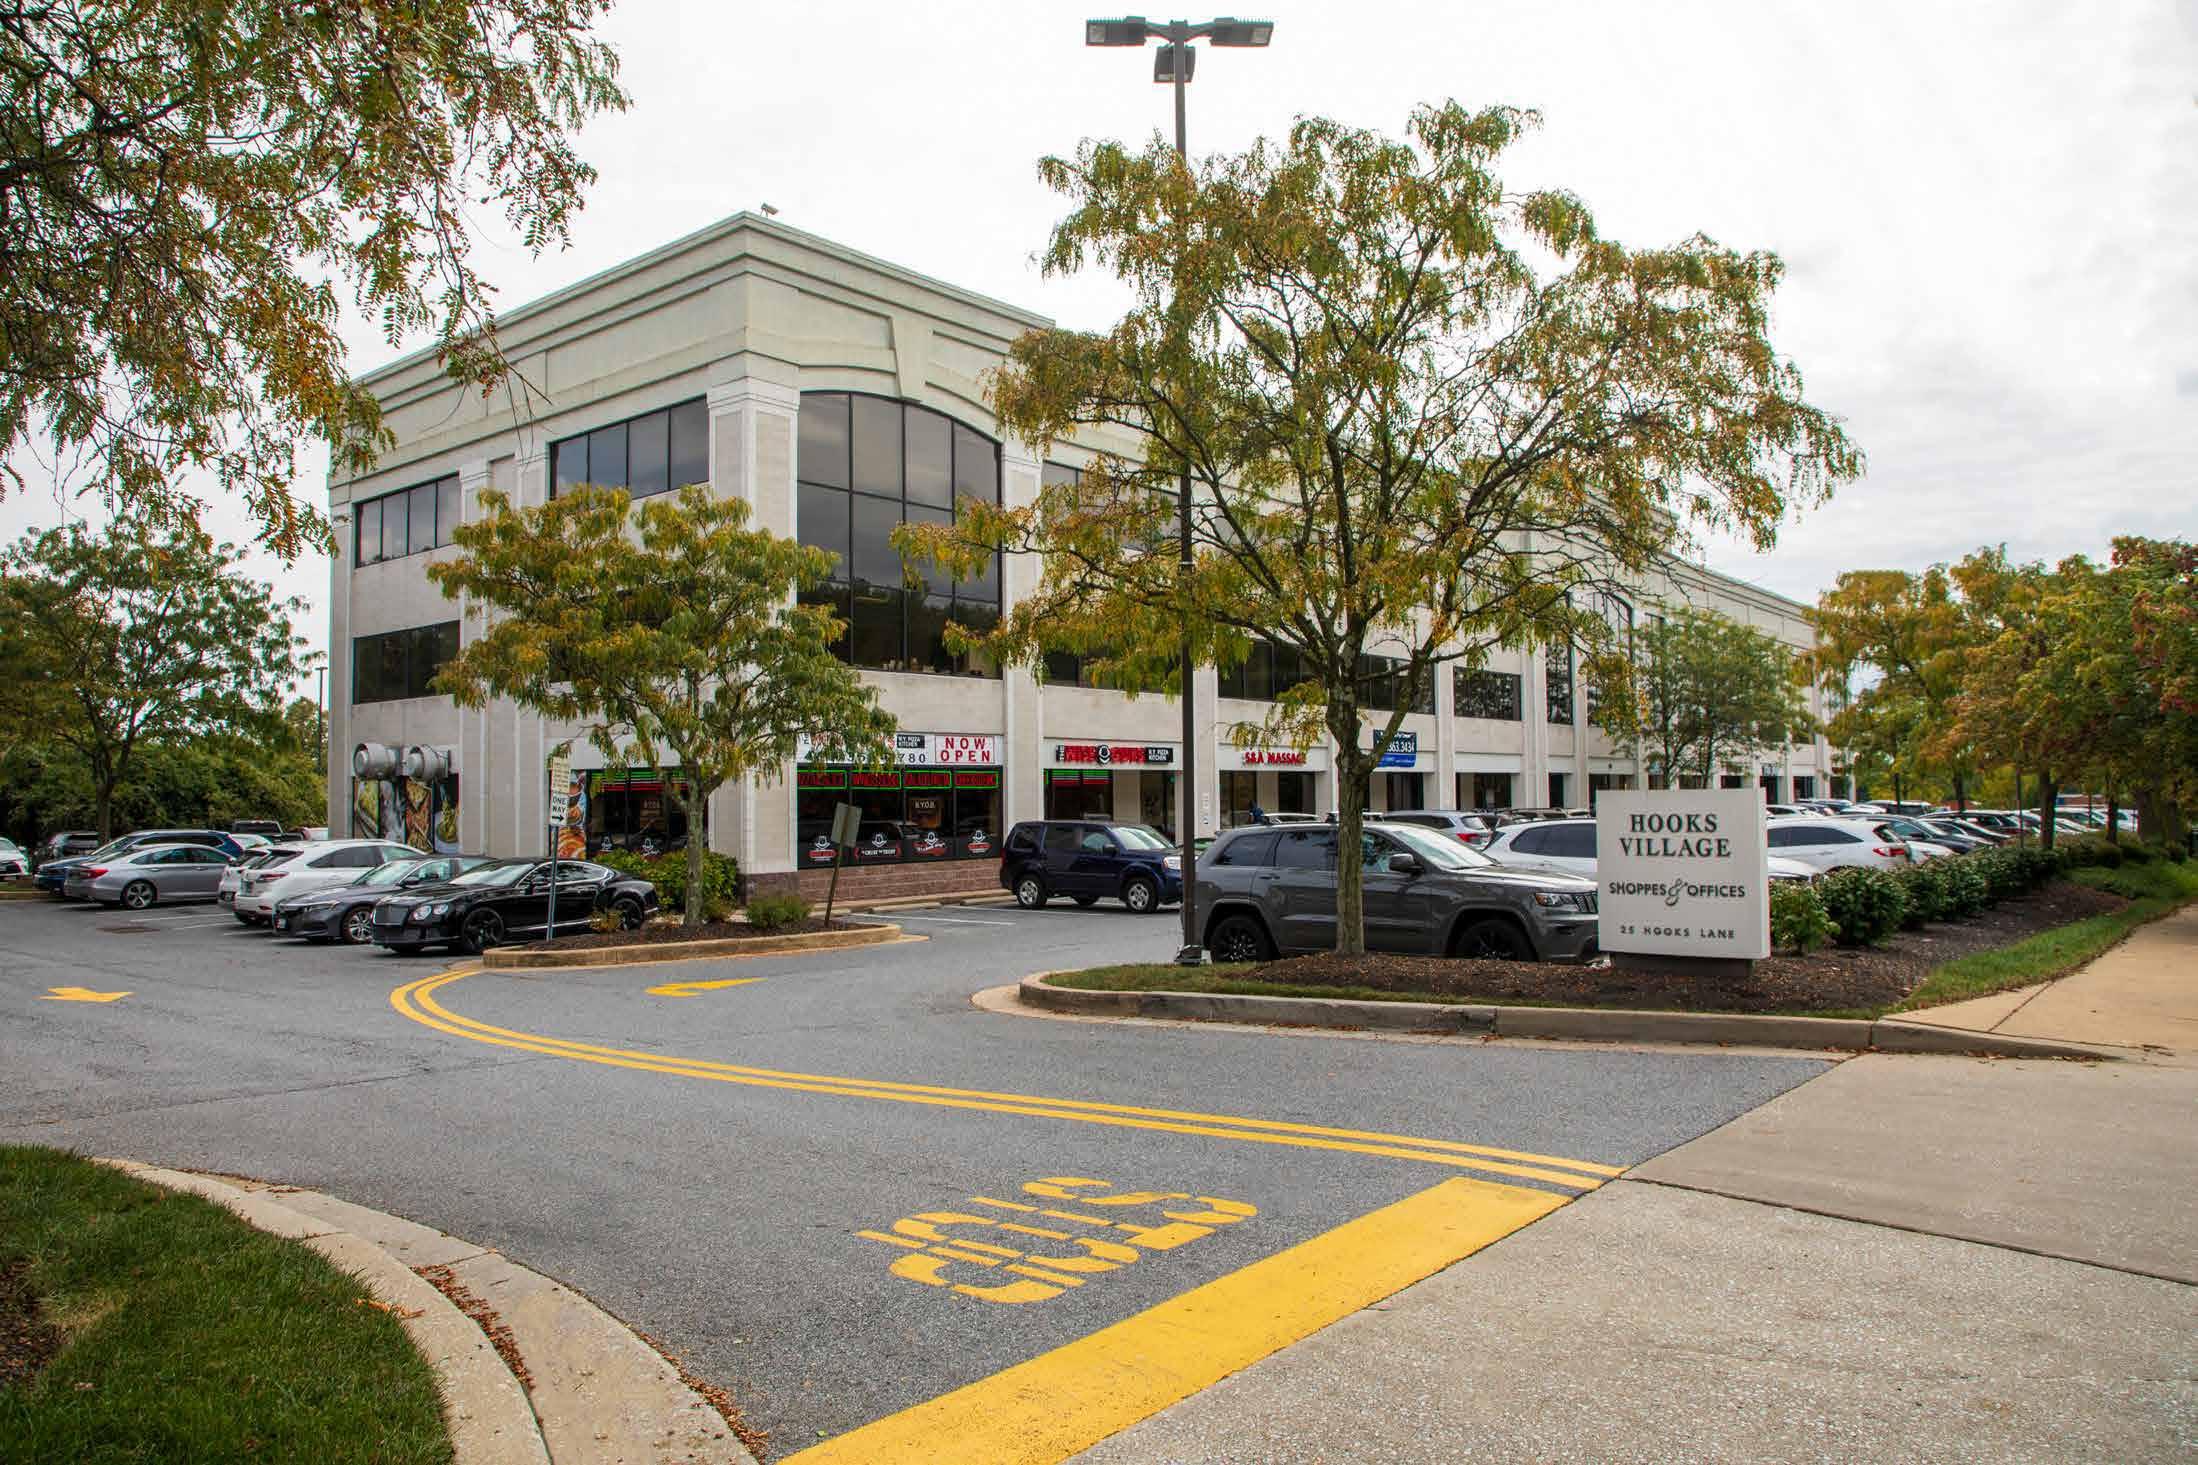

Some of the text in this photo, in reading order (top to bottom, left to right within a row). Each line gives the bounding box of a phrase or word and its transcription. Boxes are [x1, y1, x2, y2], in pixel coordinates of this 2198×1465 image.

[945, 737, 986, 750] NOW
[940, 750, 991, 762] OPEN
[552, 797, 567, 805] ONE
[552, 805, 566, 813] WAY
[1630, 813, 1718, 834] HOOKS
[1619, 837, 1731, 858] VILLAGE
[1608, 881, 1667, 897] SHOPPES
[1686, 884, 1746, 899] OFFICES
[1619, 924, 1736, 940] 25 HOOKS LANE
